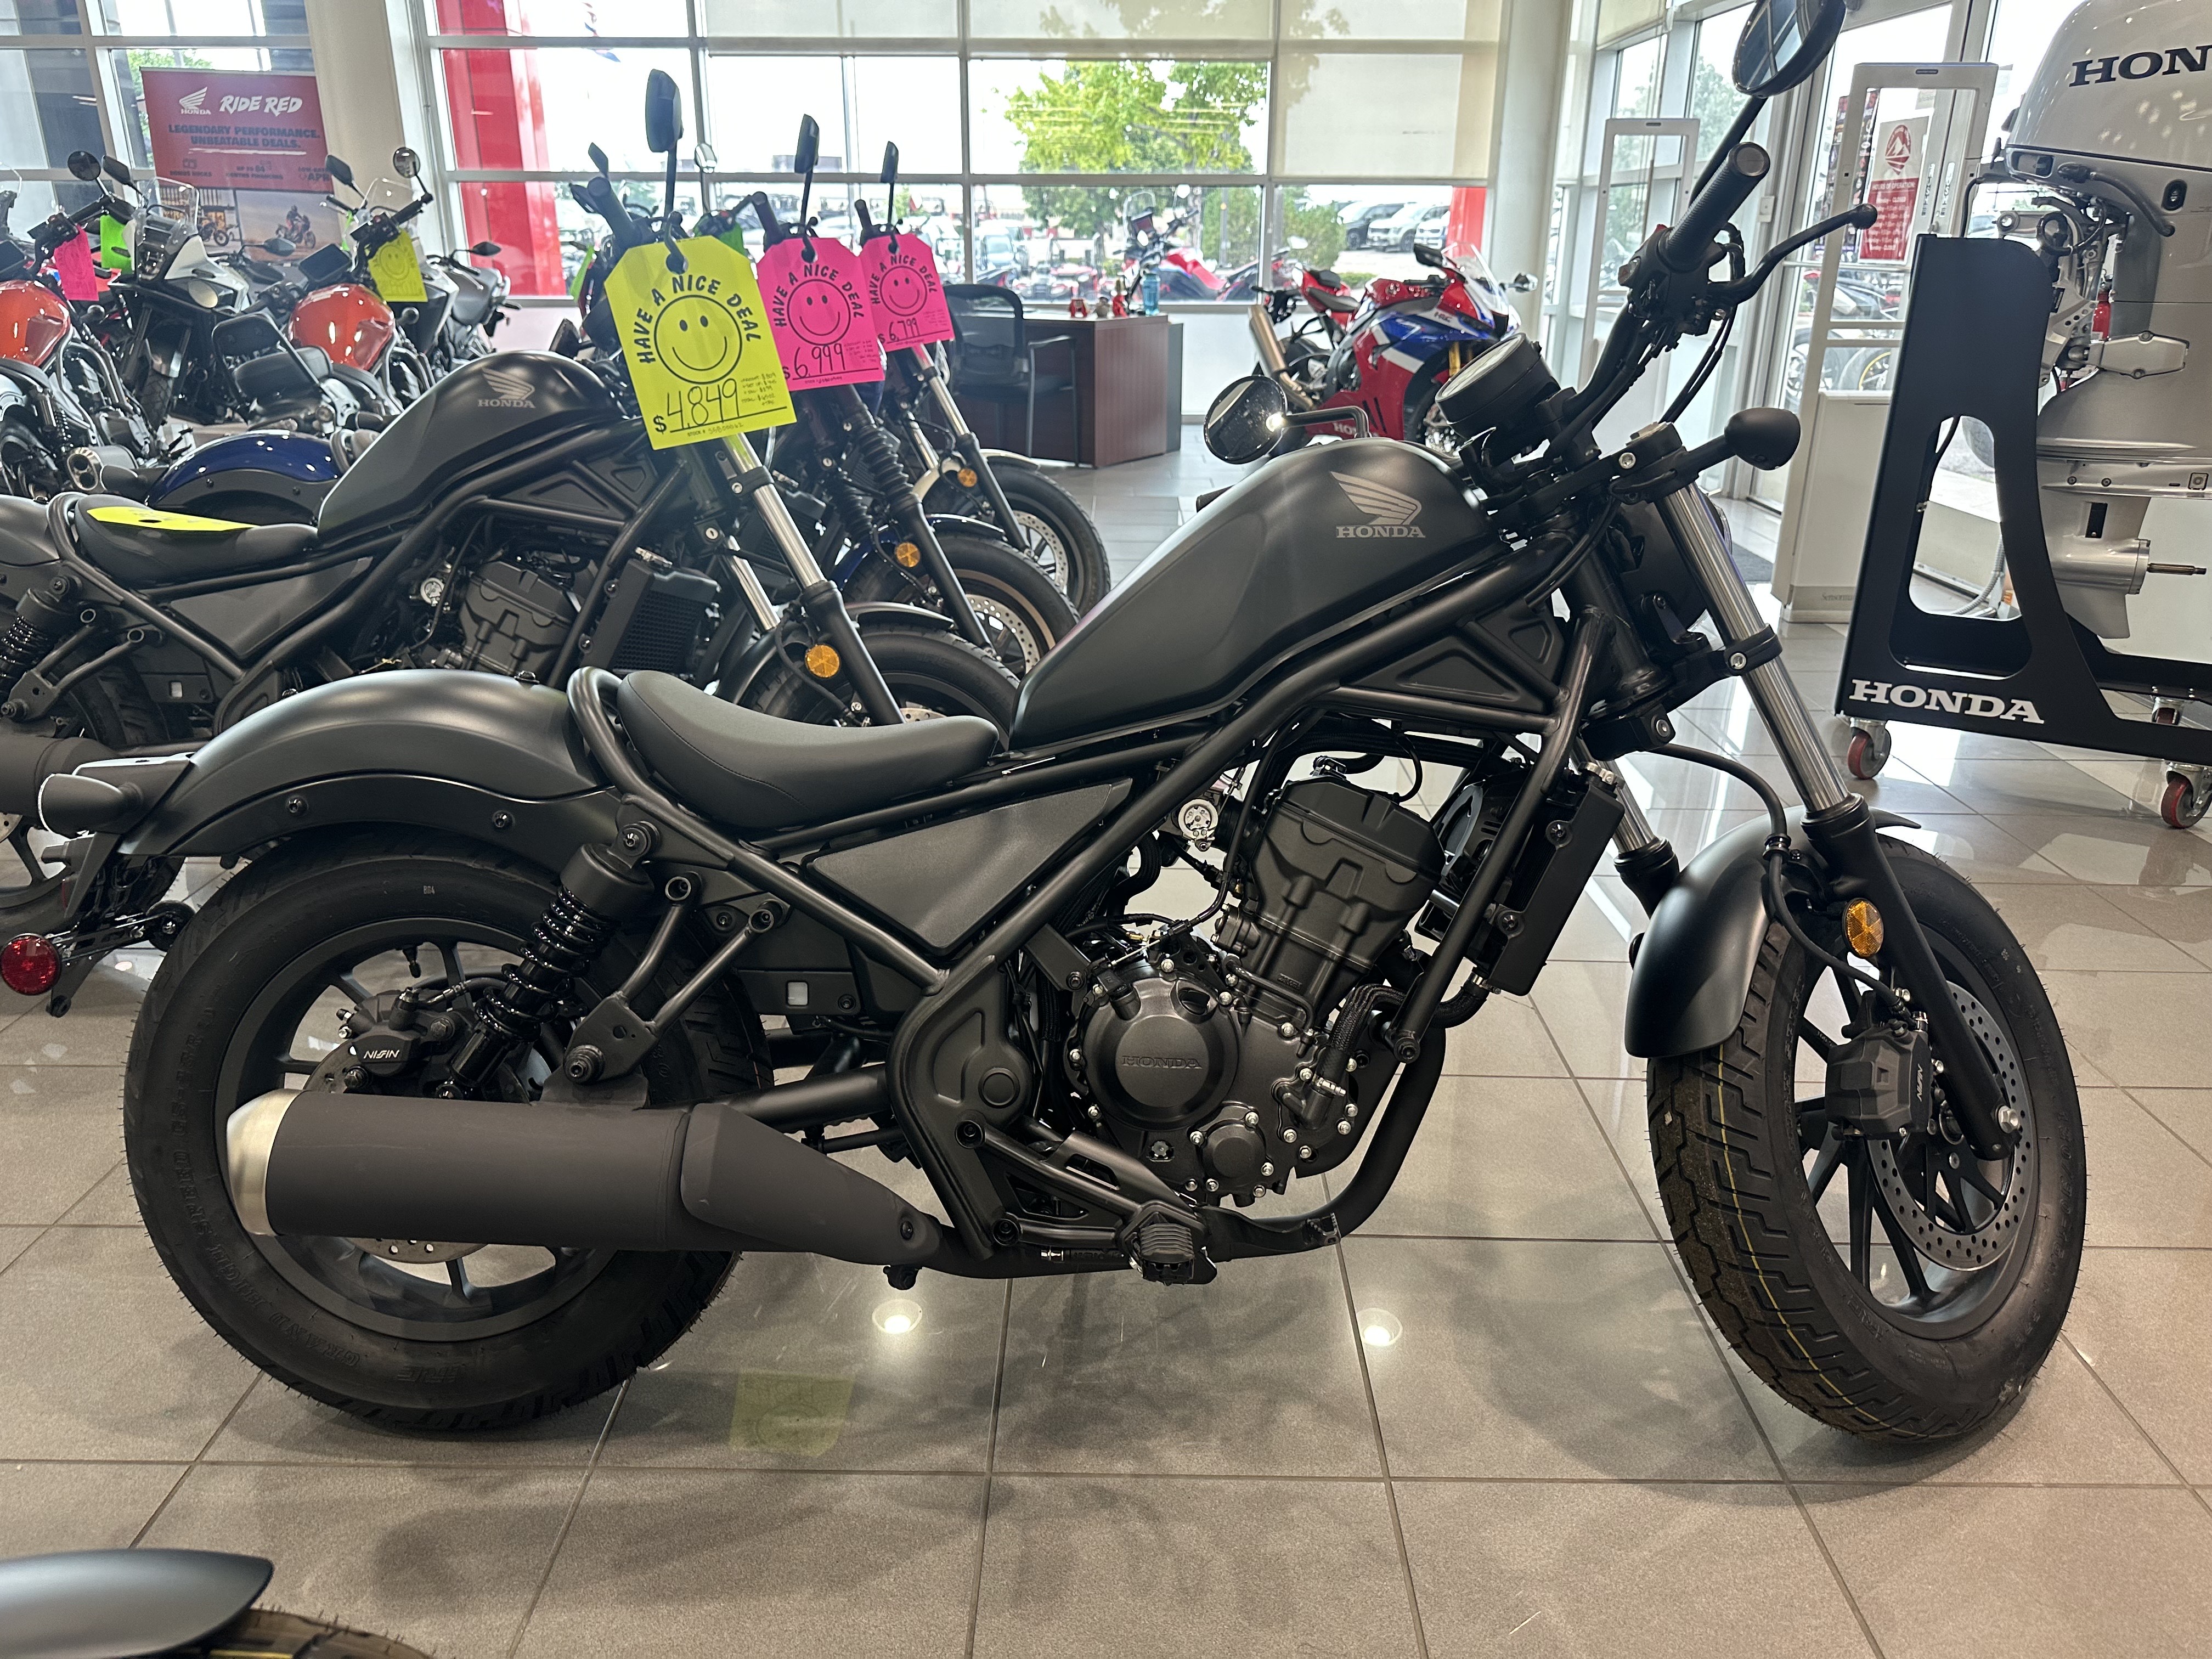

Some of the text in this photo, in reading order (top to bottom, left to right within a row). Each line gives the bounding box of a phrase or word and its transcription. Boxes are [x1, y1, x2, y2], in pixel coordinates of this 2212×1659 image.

[219, 95, 303, 117] RIDE RED
[168, 125, 320, 138] LEGENDARY PERFORMANCE.
[190, 136, 301, 148] UNBEATABLE DEALS.
[869, 255, 937, 304] HAVE A NICE DEAL
[772, 264, 864, 327] HAVE A NICE DEAL
[633, 274, 761, 364] HAVE A NICE DEAL
[478, 399, 536, 408] HONDA
[1336, 526, 1426, 538] HONDA
[1849, 679, 2045, 725] HONDA
[363, 1049, 400, 1059] NISSIN
[1122, 1056, 1203, 1069] HONDA
